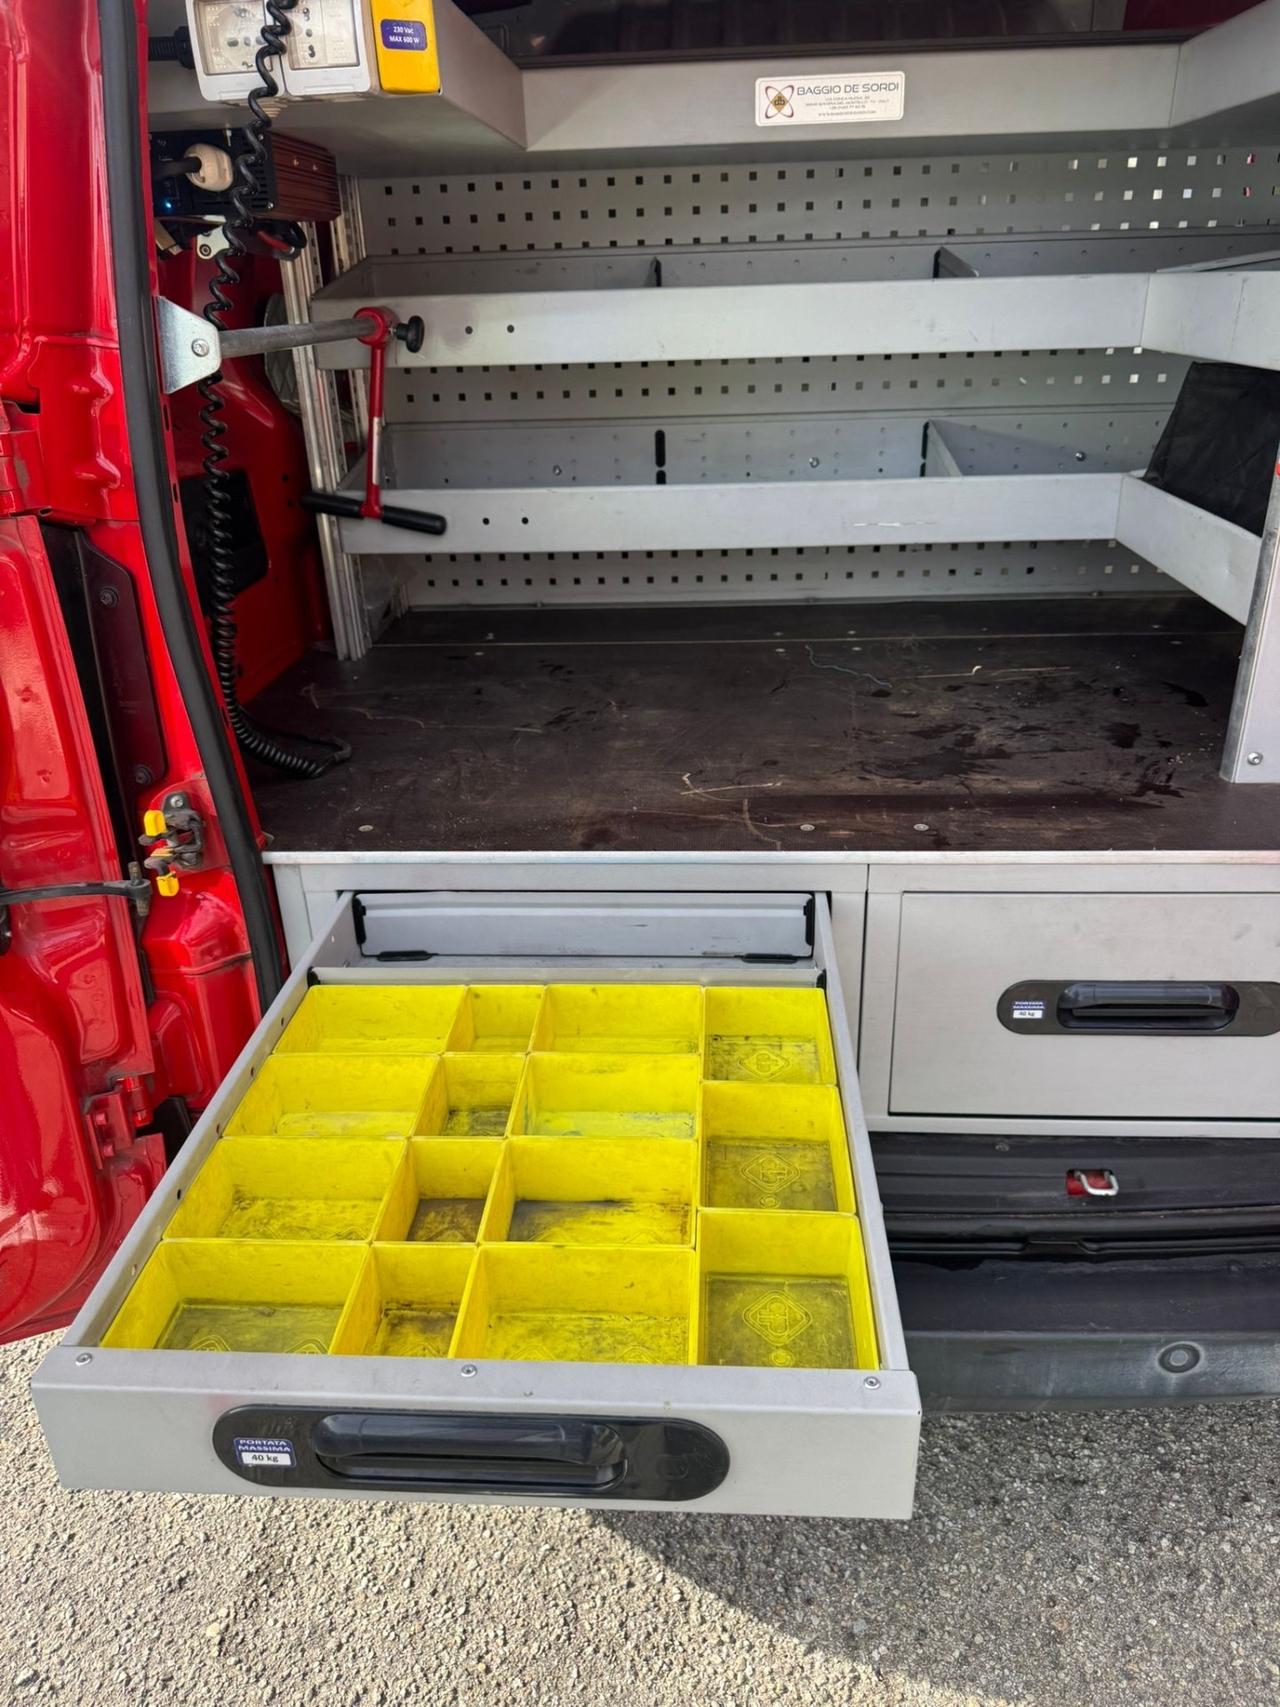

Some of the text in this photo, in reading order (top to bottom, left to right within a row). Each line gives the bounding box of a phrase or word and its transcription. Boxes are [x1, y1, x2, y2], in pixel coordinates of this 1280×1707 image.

[797, 82, 899, 96] BAGGIO DE SORDI
[266, 1454, 279, 1463] kg
